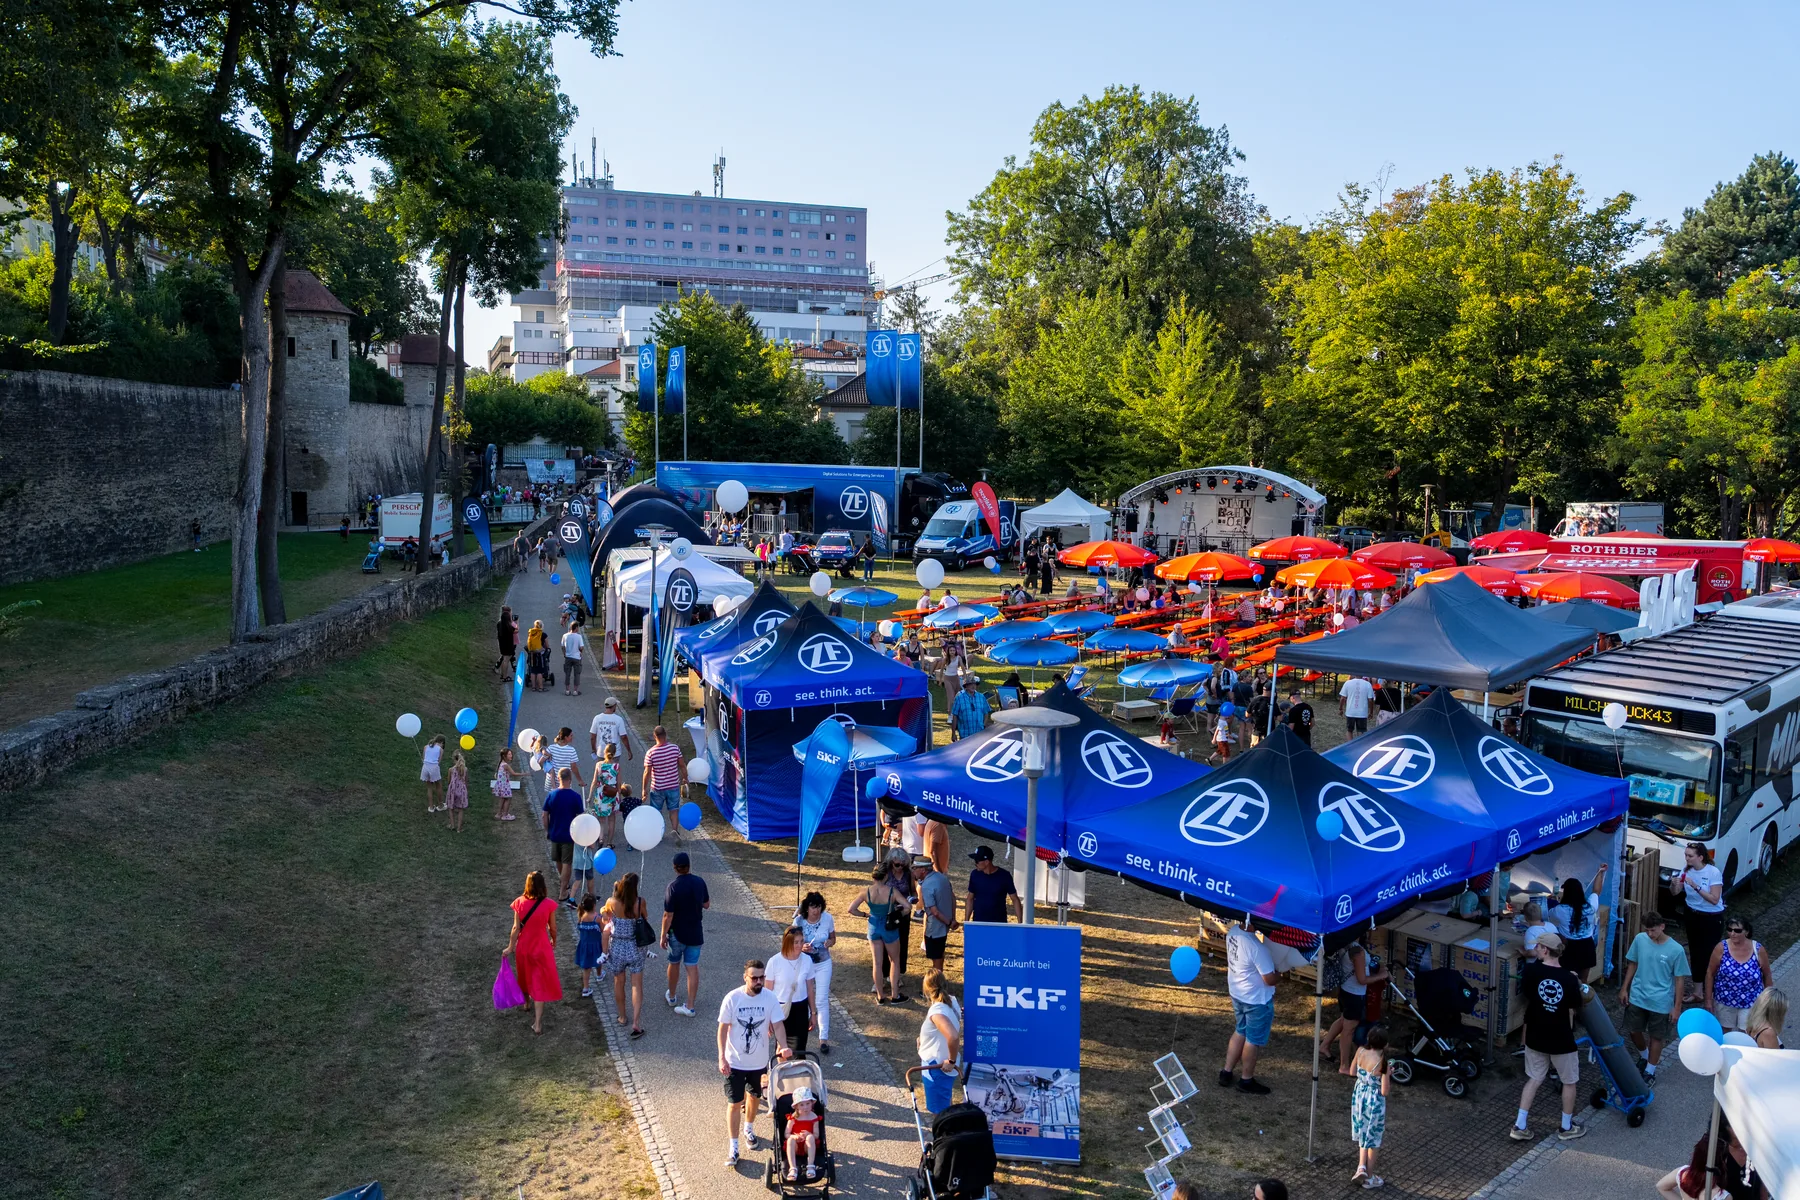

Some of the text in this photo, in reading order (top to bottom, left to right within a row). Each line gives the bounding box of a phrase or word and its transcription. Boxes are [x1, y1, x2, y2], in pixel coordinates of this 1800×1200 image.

[1570, 545, 1658, 556] ROTH BIER
[795, 690, 818, 701] see.
[820, 687, 852, 699] think.
[855, 686, 875, 696] act.
[1565, 695, 1673, 723] MILCHUCK43
[816, 750, 841, 765] SKF
[922, 789, 943, 805] see.
[946, 795, 978, 816] think.
[980, 809, 1002, 824] act.
[1539, 823, 1555, 838] see.
[1556, 810, 1580, 830] think.
[1581, 806, 1596, 821] act.
[1126, 853, 1154, 872] see.
[1158, 860, 1201, 886] think.
[1205, 877, 1235, 897] act.
[1376, 886, 1397, 902] see.
[1400, 874, 1431, 893] think.
[1432, 863, 1452, 879] act.
[977, 957, 1051, 970] Deine Zukunft bei
[977, 985, 1067, 1011] SKF
[1002, 1125, 1032, 1135] SKF
